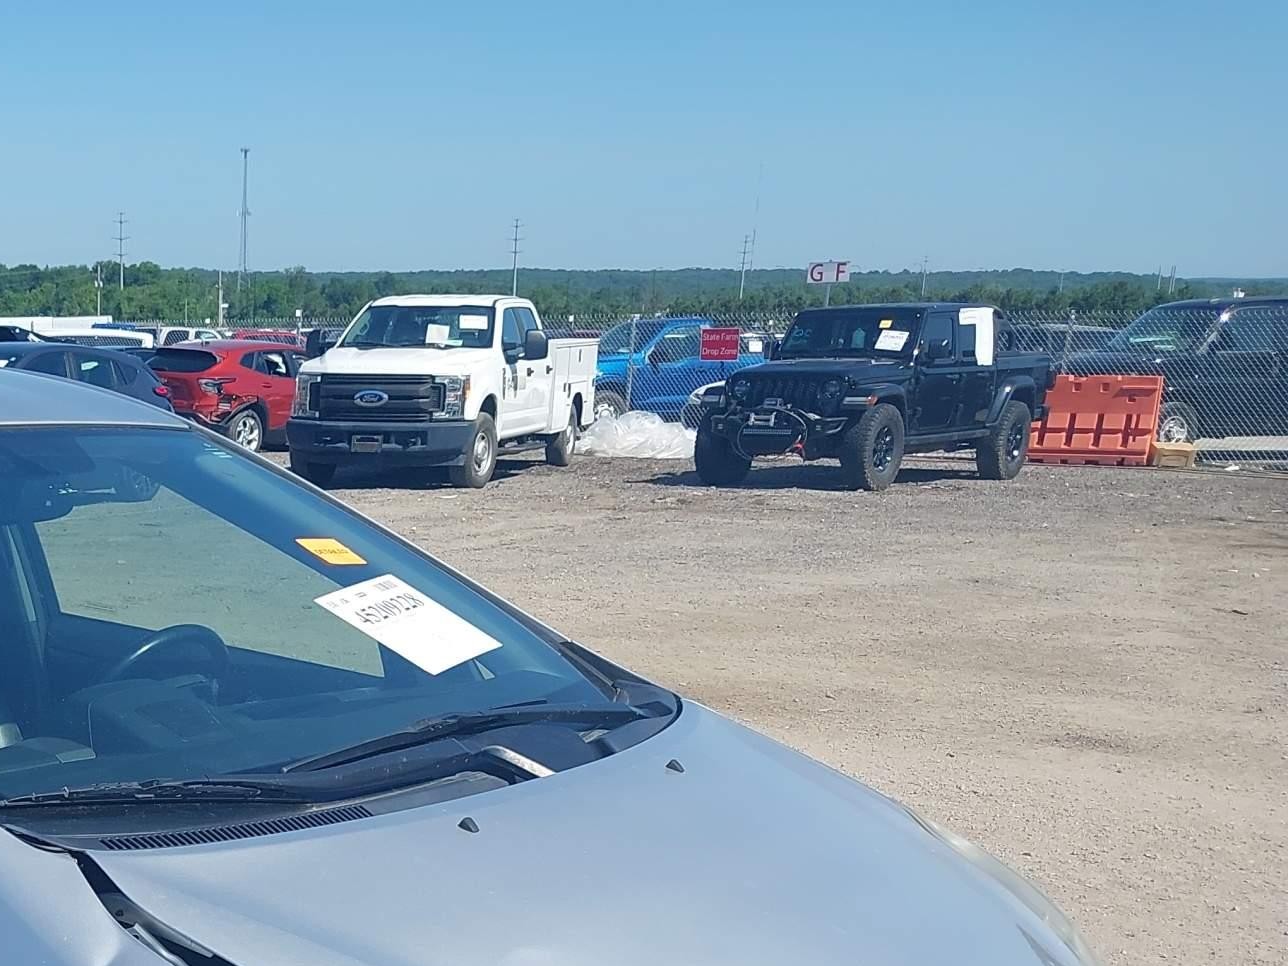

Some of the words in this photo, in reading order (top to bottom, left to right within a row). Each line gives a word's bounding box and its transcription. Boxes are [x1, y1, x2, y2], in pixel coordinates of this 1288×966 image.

[810, 263, 824, 281] G
[836, 262, 847, 281] F
[703, 332, 720, 341] State
[720, 332, 738, 341] Farm
[702, 347, 720, 356] Drop
[720, 347, 737, 355] Zone
[355, 593, 424, 623] 45209228
